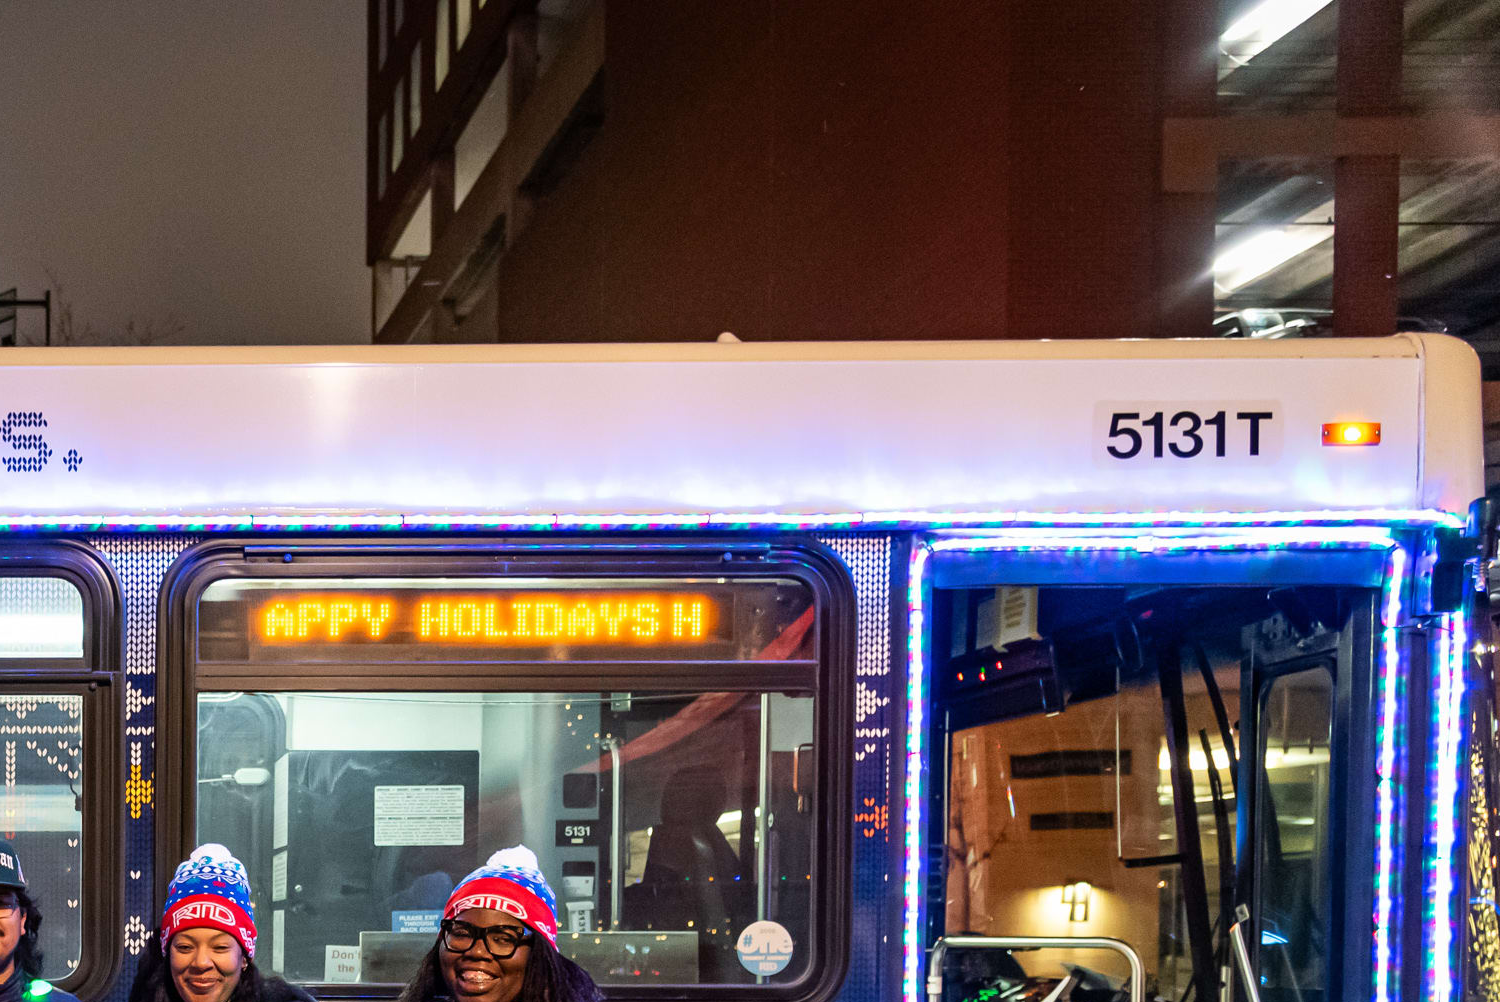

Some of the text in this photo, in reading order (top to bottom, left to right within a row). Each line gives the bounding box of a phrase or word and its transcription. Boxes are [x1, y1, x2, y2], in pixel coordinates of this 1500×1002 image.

[1106, 410, 1273, 460] 5131T
[265, 601, 390, 638] APPY
[420, 601, 660, 638] HOLIDAYS
[564, 826, 591, 837] 5131
[172, 901, 236, 928] RTD
[337, 964, 355, 973] the
